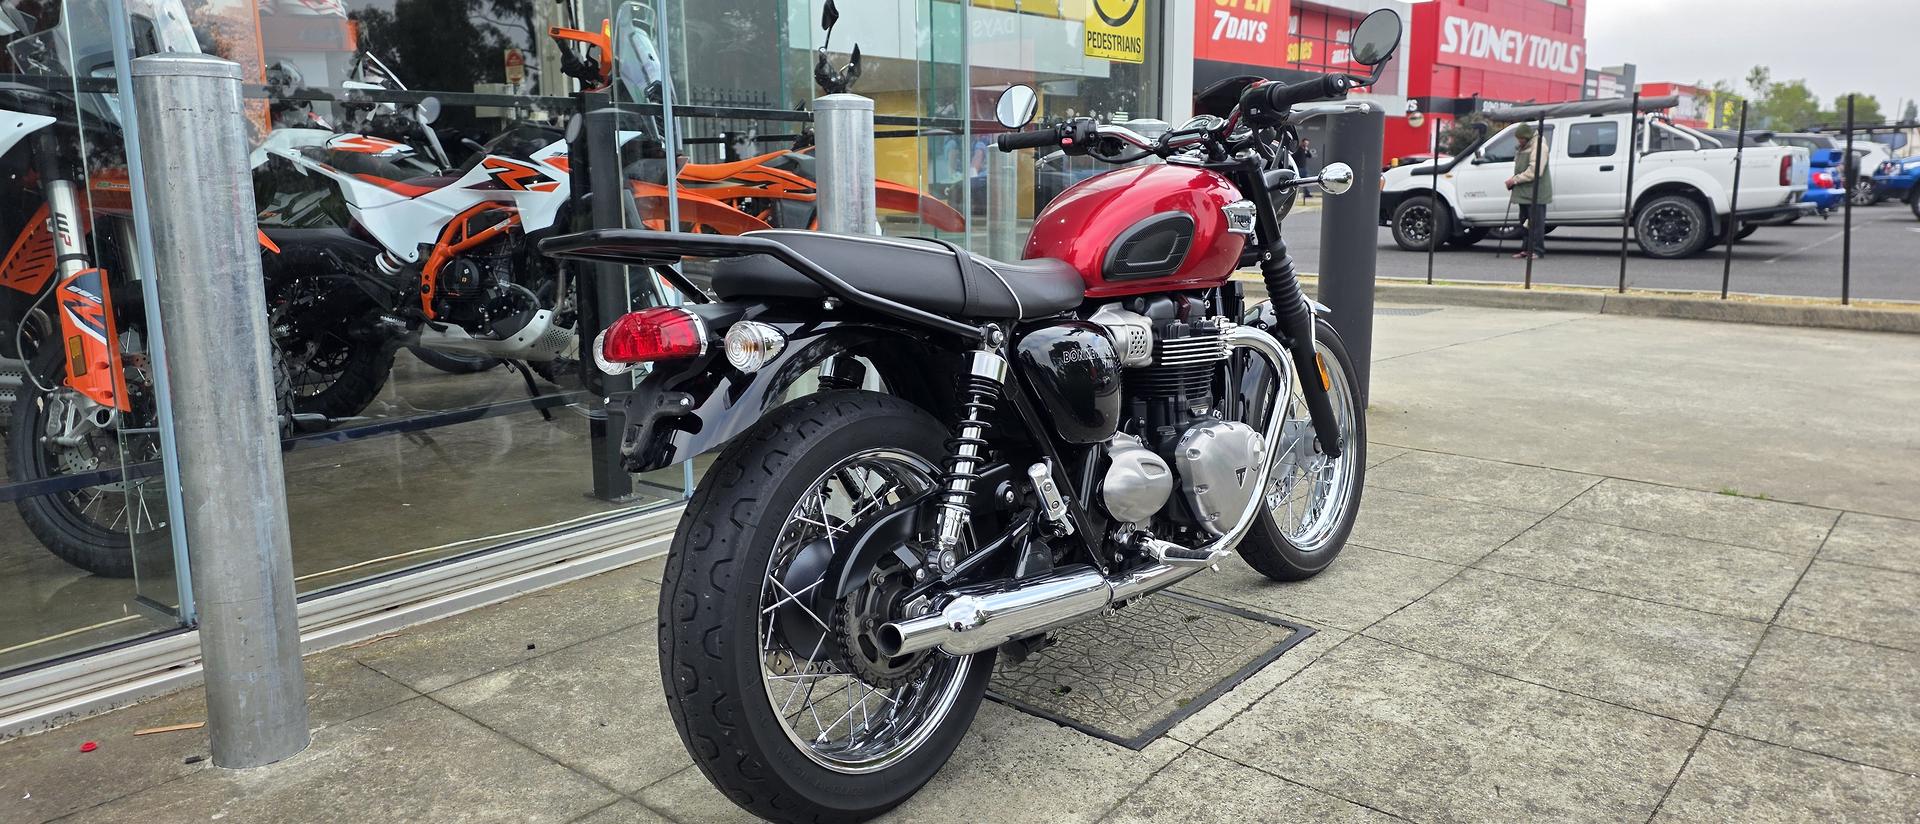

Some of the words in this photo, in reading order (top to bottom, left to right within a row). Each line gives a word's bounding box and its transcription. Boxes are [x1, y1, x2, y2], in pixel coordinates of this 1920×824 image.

[1087, 30, 1142, 54] PEDESTRIANS
[1440, 15, 1529, 65] SYDNEY
[1528, 34, 1582, 75] TOOLS
[55, 211, 72, 247] WP
